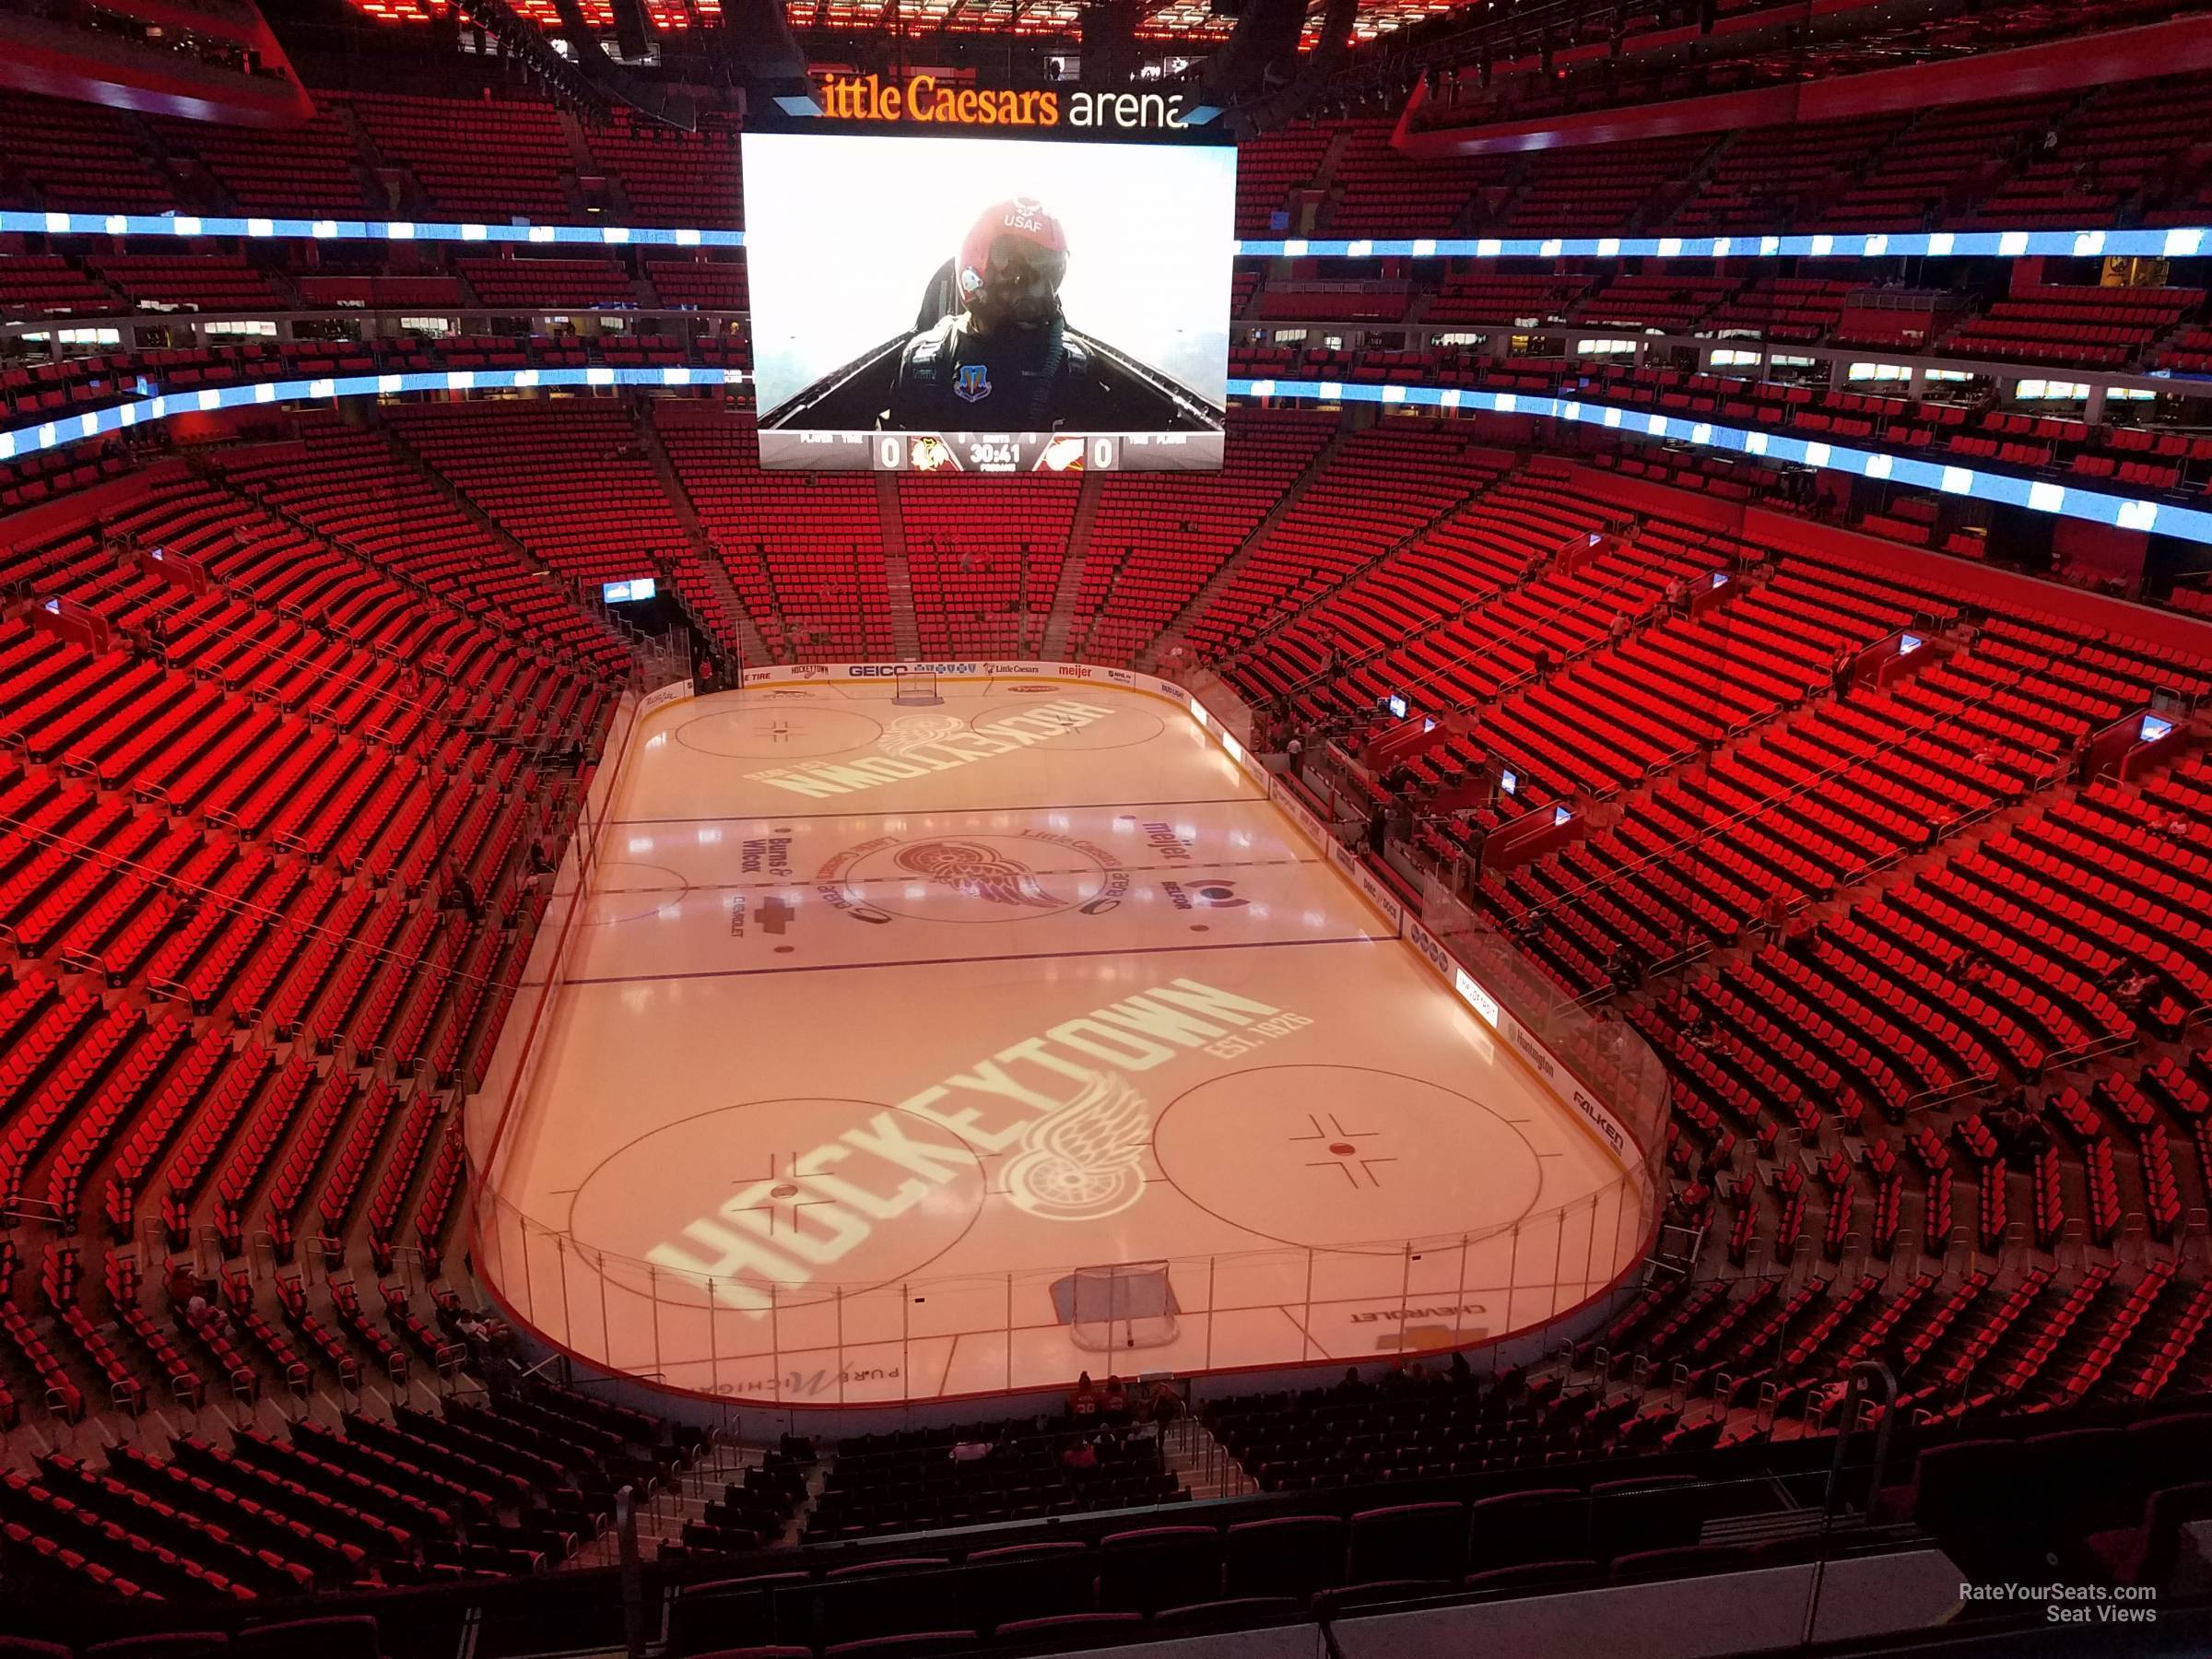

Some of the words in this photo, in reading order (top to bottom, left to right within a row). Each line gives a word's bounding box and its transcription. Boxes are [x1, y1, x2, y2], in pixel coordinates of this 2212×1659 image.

[816, 73, 901, 122] ittle
[906, 75, 1059, 126] Caesars
[1069, 91, 1189, 128] arena
[1004, 214, 1042, 232] USAF
[881, 437, 900, 468] 0
[1094, 438, 1112, 468] 0
[752, 672, 771, 681] TIRE
[1058, 665, 1092, 678] meijer
[760, 699, 1116, 799] HOCKEYTOWN
[741, 839, 767, 873] Wilcox
[768, 838, 793, 867] Burns
[1142, 822, 1193, 860] meijer
[1160, 880, 1193, 911] BELFOR
[1203, 1034, 1265, 1060] EST.
[1246, 1012, 1315, 1040] 1926
[1572, 1090, 1624, 1150] FALKEN
[646, 977, 1281, 1321] HOCKEYTOWN
[1350, 1304, 1488, 1324] CHEVROLET
[695, 1362, 854, 1395] MICHIGA
[840, 1366, 900, 1382] PURE
